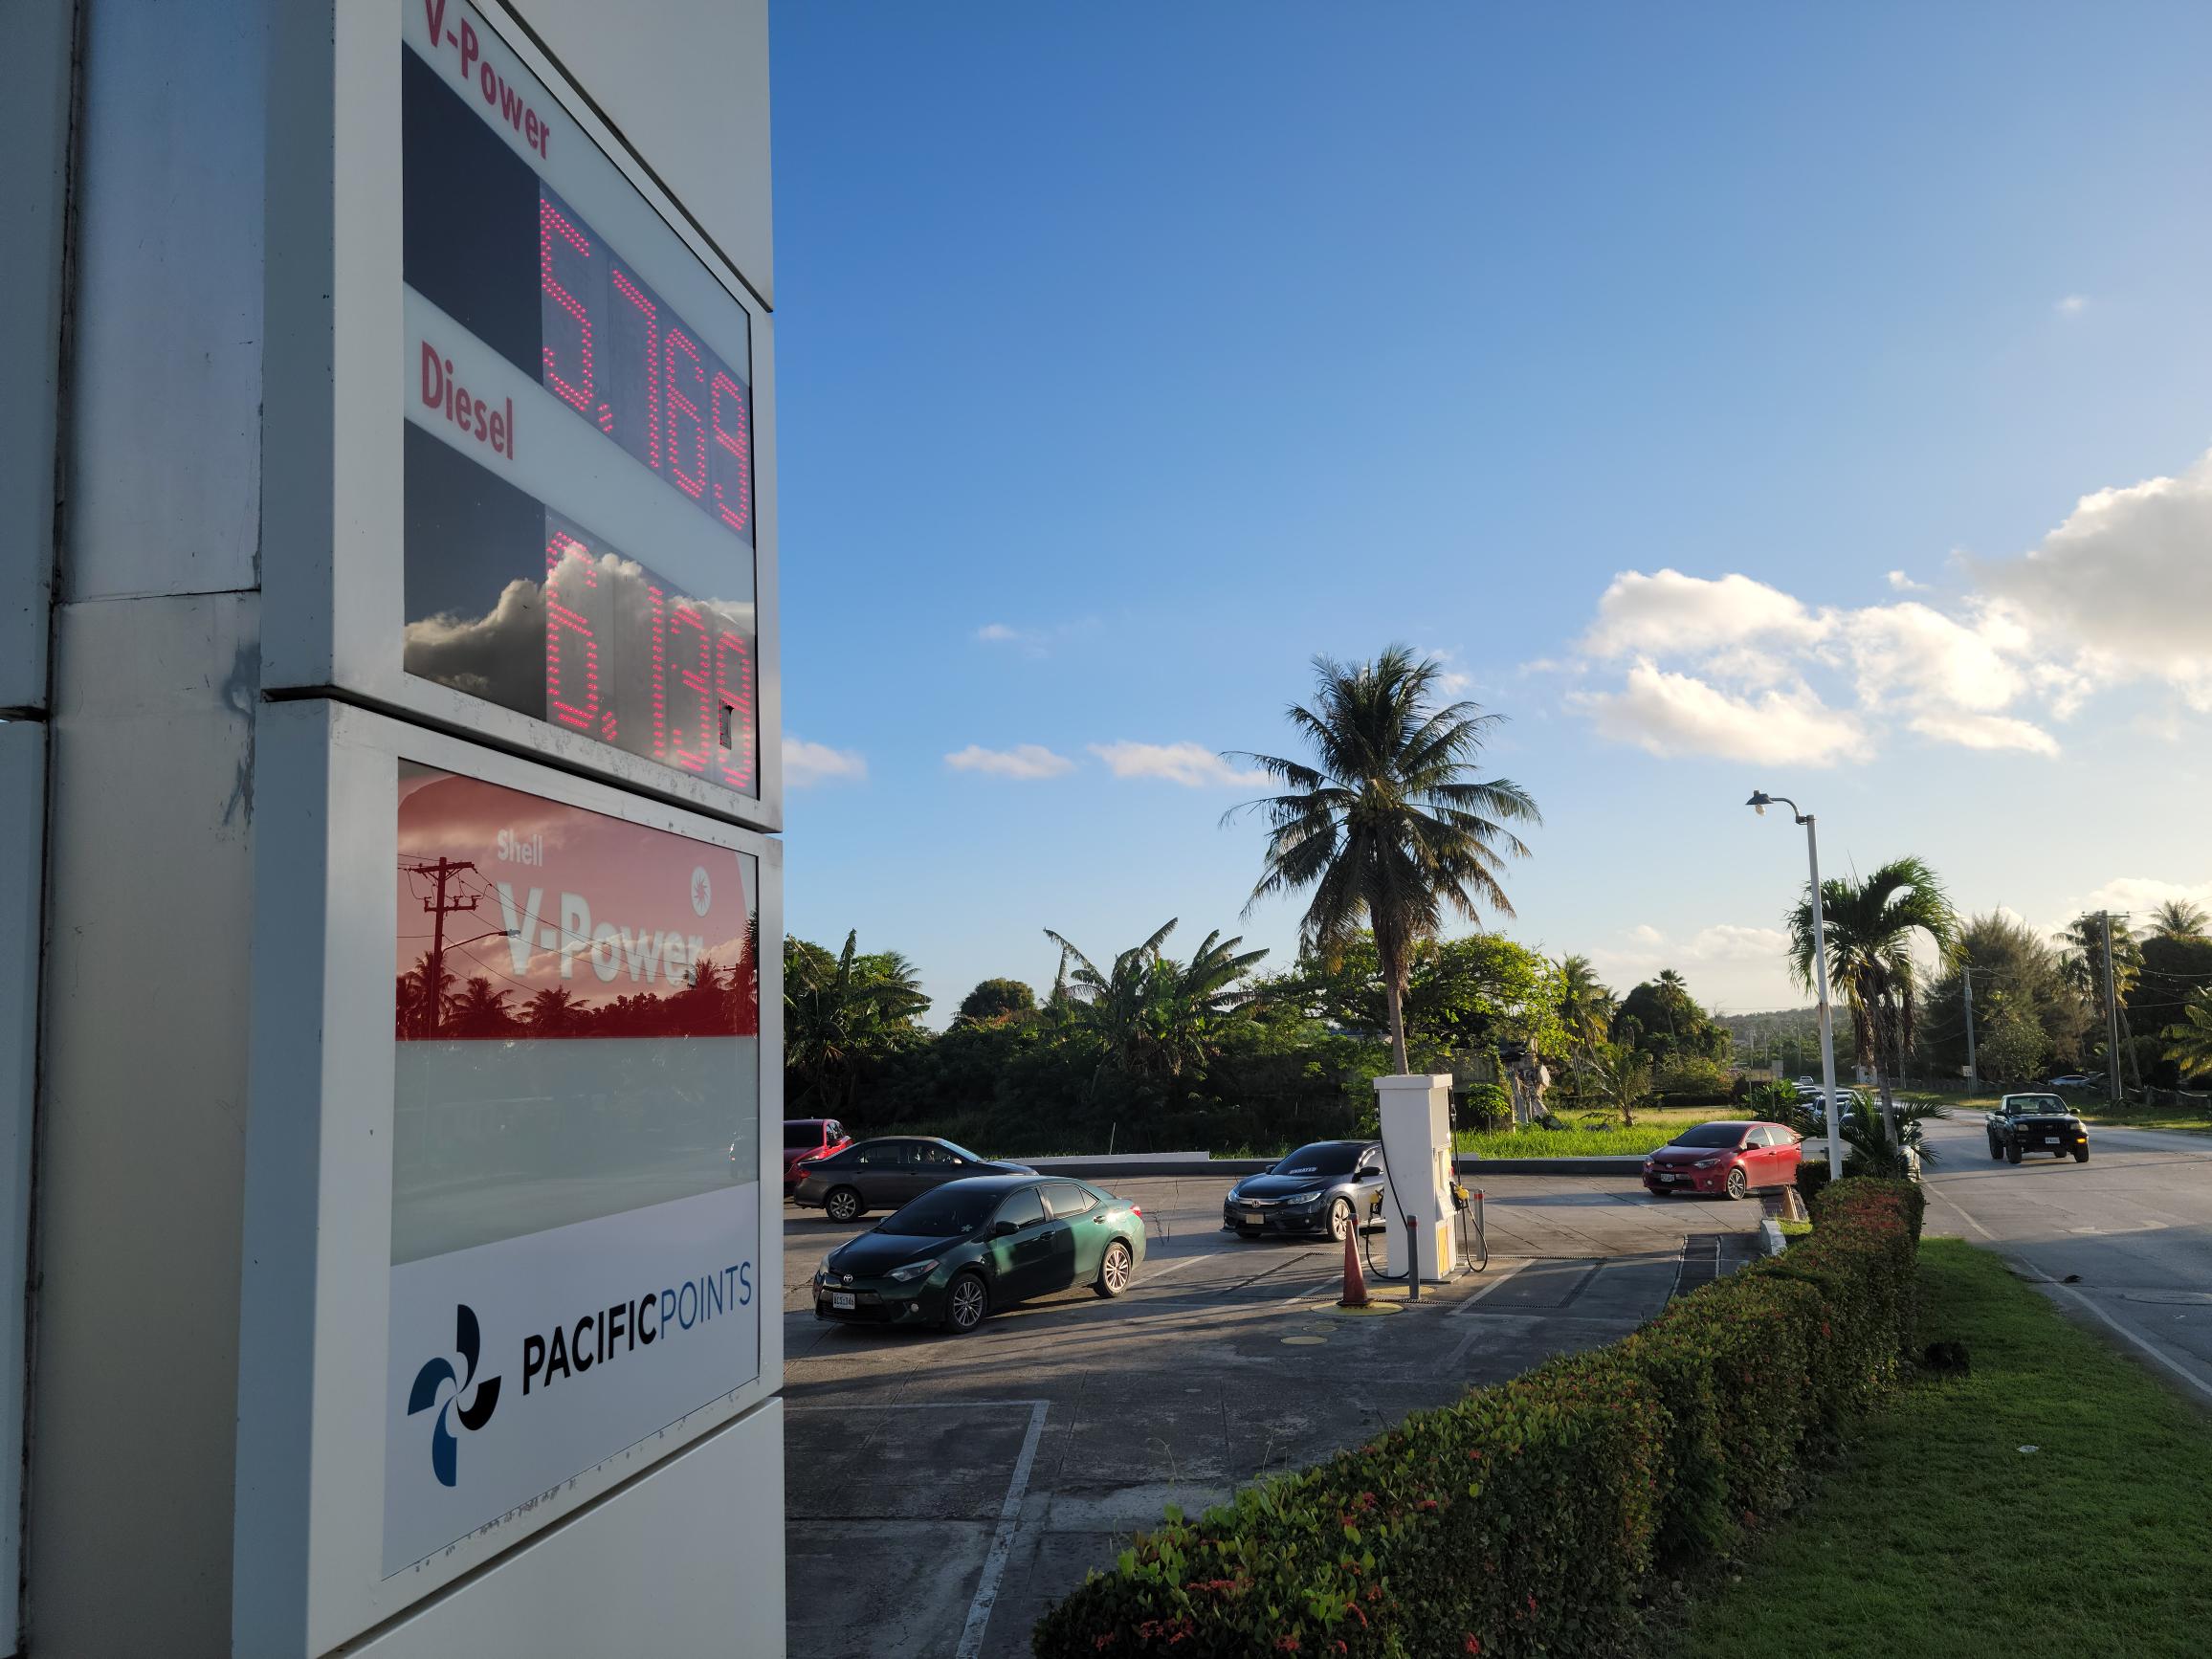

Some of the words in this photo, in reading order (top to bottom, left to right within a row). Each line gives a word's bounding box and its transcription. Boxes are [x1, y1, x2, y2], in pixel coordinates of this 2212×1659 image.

[423, 0, 550, 161] V-Power
[421, 340, 514, 461] Diesel
[497, 829, 543, 867] Shell
[495, 880, 704, 987] V-Power
[522, 1261, 752, 1397] PACIFICPOINTS
